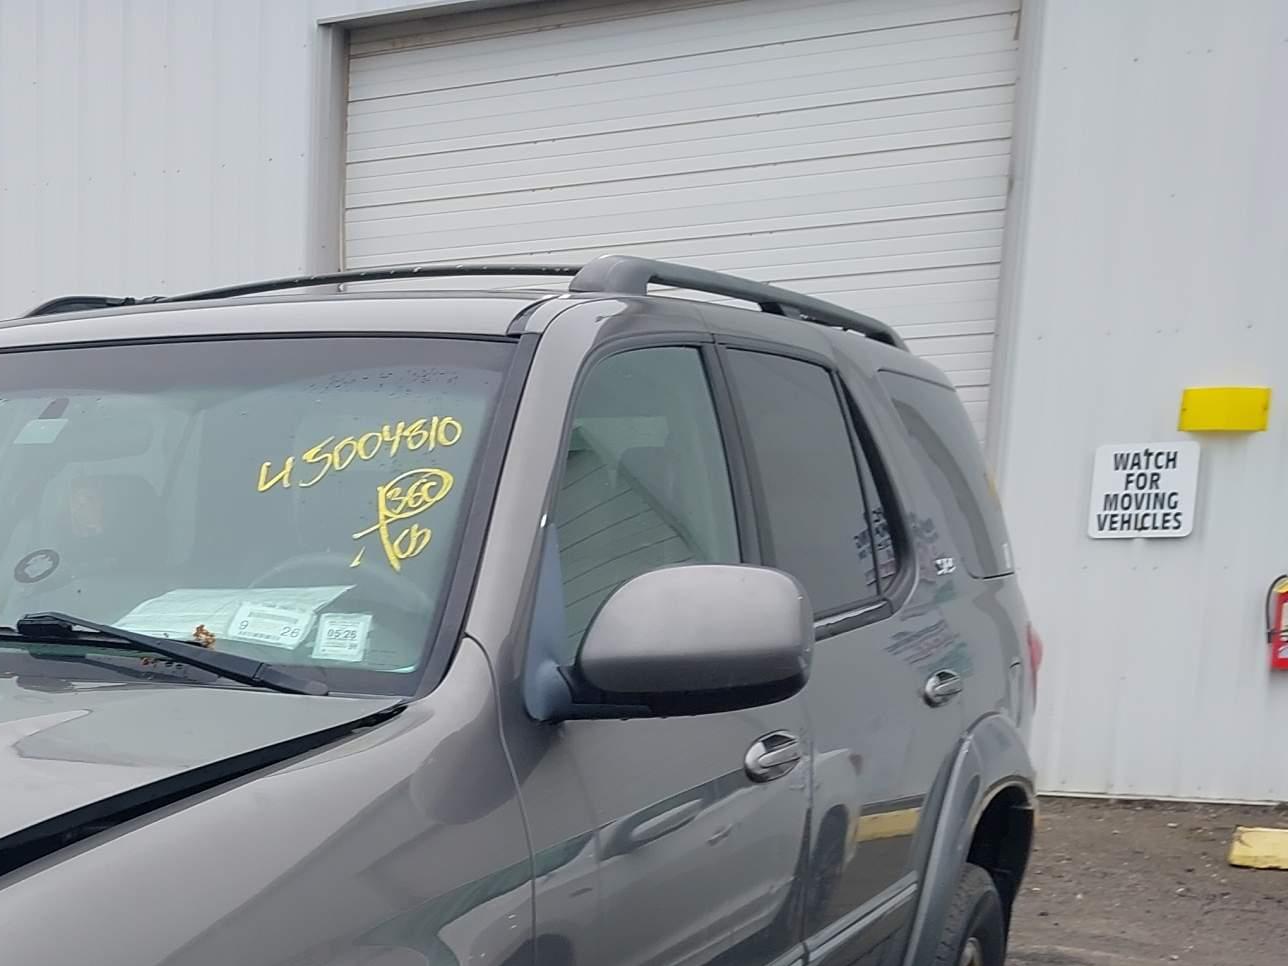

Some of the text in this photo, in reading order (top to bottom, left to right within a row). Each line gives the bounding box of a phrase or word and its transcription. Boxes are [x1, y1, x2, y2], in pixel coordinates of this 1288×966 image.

[1114, 450, 1178, 471] WATCH
[1124, 472, 1161, 491] FOR
[1103, 492, 1179, 511] MOVING
[1096, 512, 1183, 532] VEHICLES
